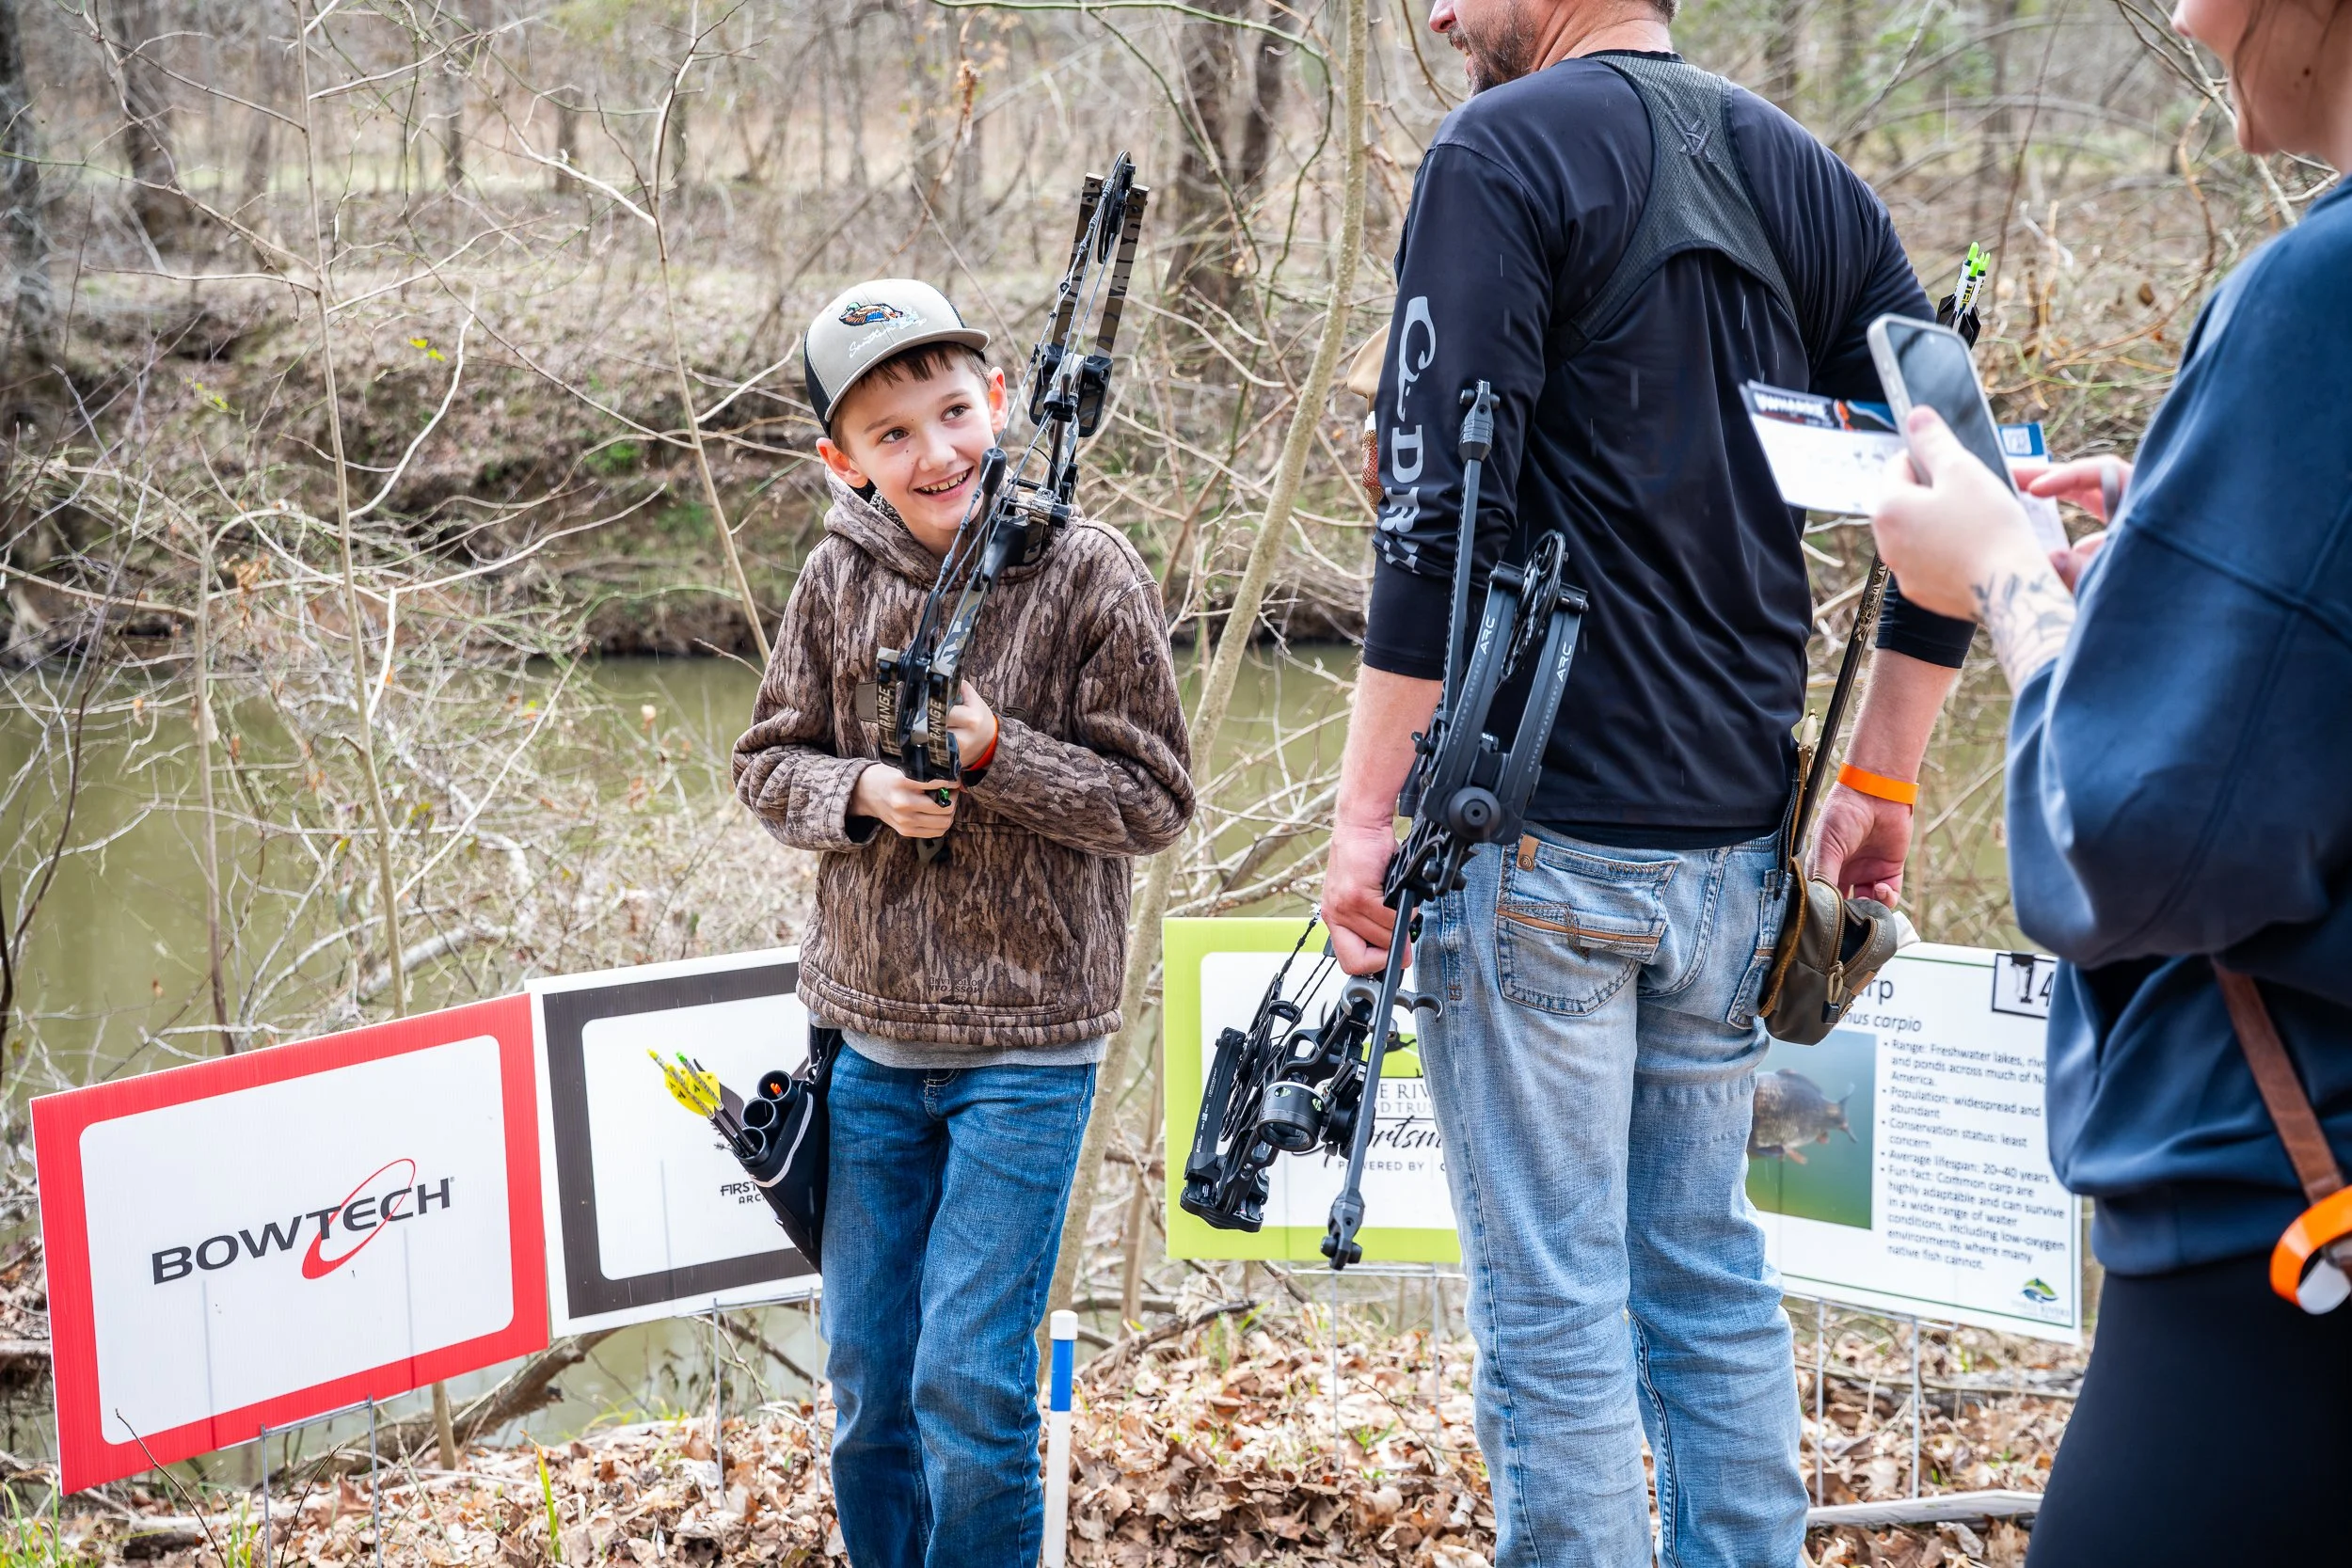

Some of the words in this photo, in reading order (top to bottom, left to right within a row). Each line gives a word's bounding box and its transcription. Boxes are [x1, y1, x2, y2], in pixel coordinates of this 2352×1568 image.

[1479, 614, 1496, 655] ARC
[1556, 641, 1572, 683] ARC
[878, 687, 892, 728] RANGE
[930, 699, 942, 742] RANGE
[1865, 978, 1894, 1005] rp
[1872, 1013, 1922, 1033] carpio
[1892, 1039, 1924, 1053] Range:
[1931, 1044, 1990, 1061] Freshwater
[1994, 1052, 2024, 1067] lakes,
[1891, 1056, 1911, 1067] and
[1915, 1059, 1946, 1070] ponds
[1949, 1065, 1982, 1077] across
[1985, 1069, 2016, 1081] much
[2019, 1072, 2030, 1083] of
[1891, 1071, 1937, 1086] America.
[1890, 1103, 1940, 1119] abundant
[1891, 1086, 1949, 1104] Population:
[1954, 1097, 2017, 1114] widespread
[2021, 1106, 2041, 1117] and
[1889, 1117, 1959, 1136] Conservation
[1962, 1129, 1997, 1144] status:
[2000, 1133, 2027, 1148] least
[1889, 1135, 1931, 1148] concern
[1338, 1161, 1403, 1172] PERED
[1408, 1161, 1424, 1171] BY
[1889, 1150, 1931, 1165] Average
[1934, 1155, 1979, 1173] lifespan:
[2019, 1170, 2050, 1183] years
[1889, 1165, 1908, 1177] Fun
[1910, 1168, 1932, 1181] fact:
[1936, 1172, 1986, 1189] Common
[1988, 1182, 2013, 1196] carp
[2016, 1187, 2034, 1197] are
[739, 1195, 766, 1205] ARC
[1888, 1180, 1920, 1196] highly
[1923, 1187, 1976, 1206] adaptable
[1979, 1196, 1999, 1208] and
[2002, 1201, 2022, 1211] can
[2025, 1204, 2065, 1219] survive
[1888, 1196, 1899, 1207] in
[1910, 1200, 1935, 1212] wide
[1938, 1206, 1968, 1219] range
[1972, 1210, 1984, 1221] of
[1986, 1214, 2018, 1227] water
[151, 1177, 451, 1285] BOWTECH
[1887, 1229, 1961, 1250] environments
[1964, 1242, 1998, 1256] where
[2001, 1250, 2033, 1264] many
[1888, 1213, 1946, 1232] conditions,
[1948, 1223, 1998, 1242] including
[2001, 1230, 2066, 1251] low-oxygen
[1887, 1244, 1919, 1259] native
[1922, 1250, 1942, 1261] fish
[1945, 1254, 1985, 1270] cannot.
